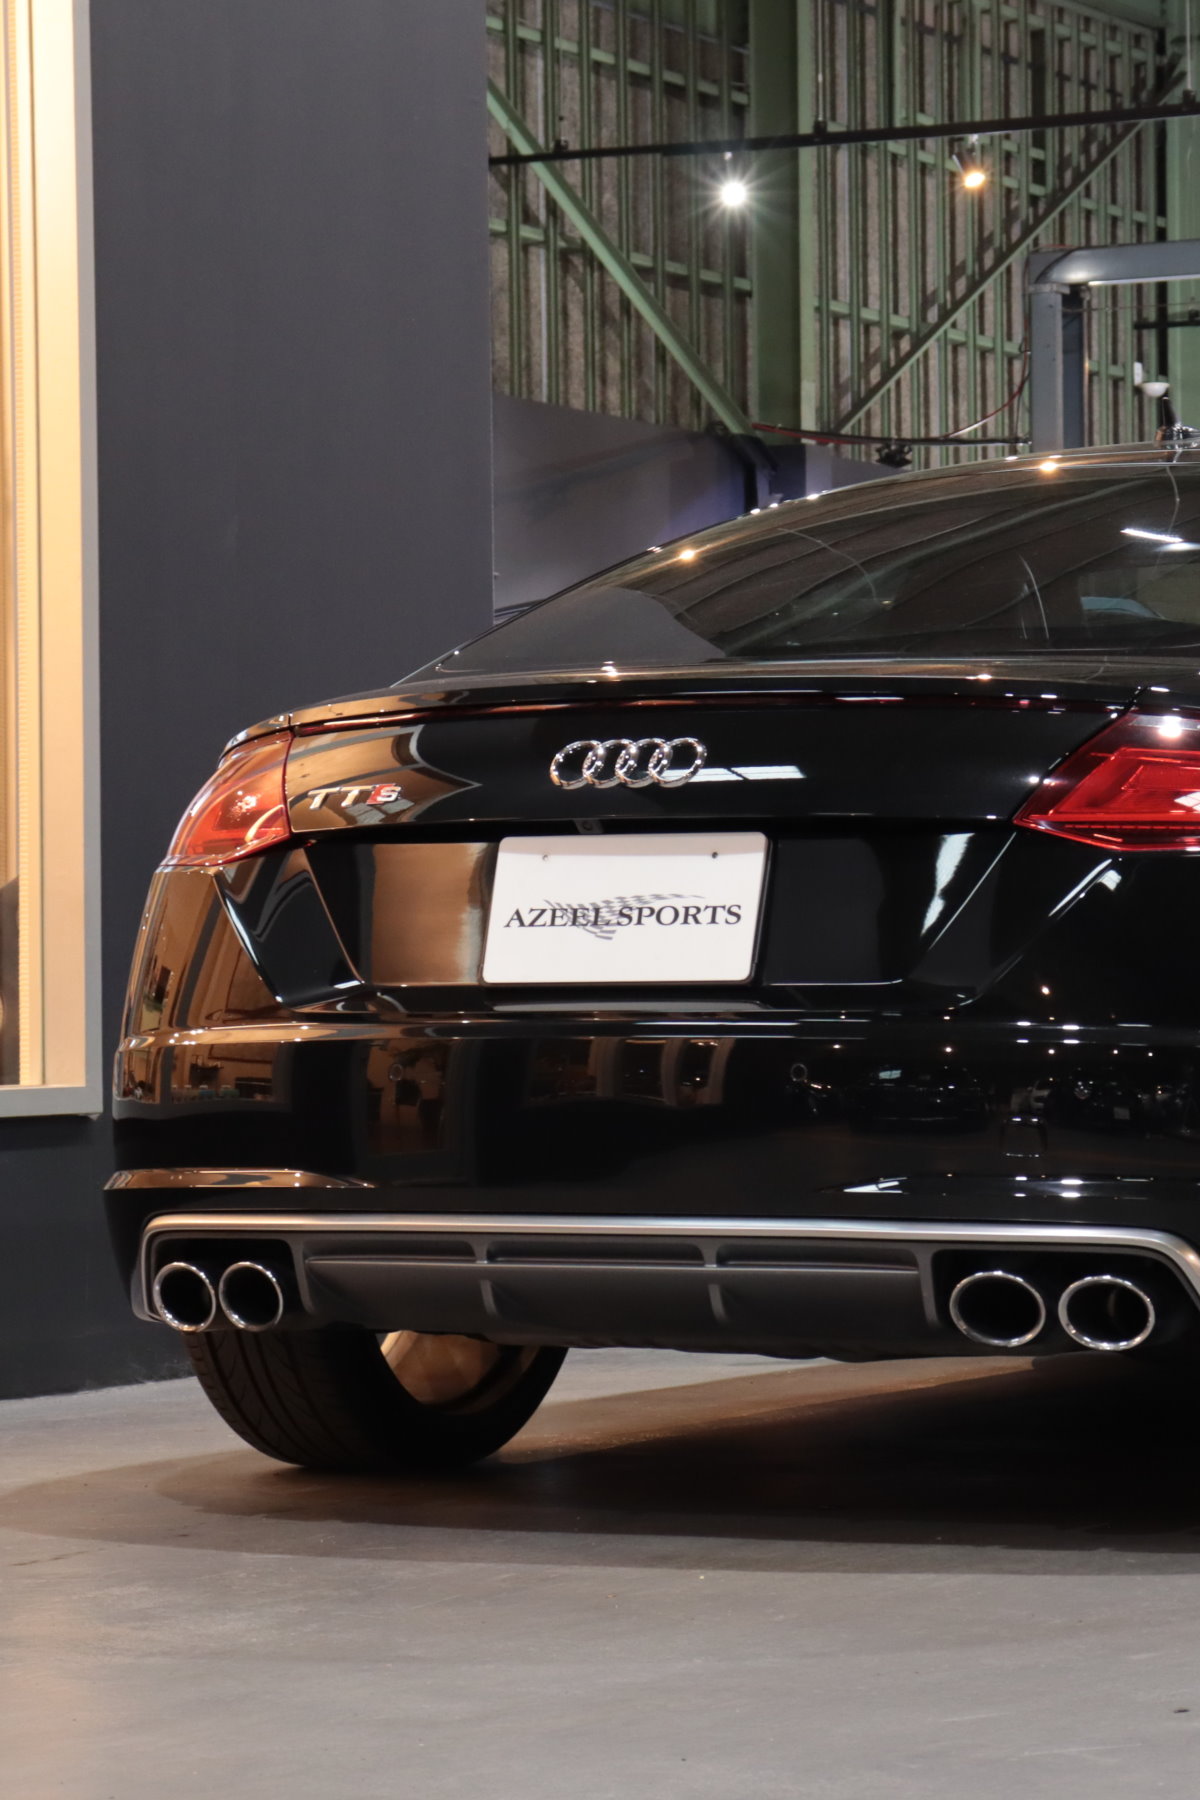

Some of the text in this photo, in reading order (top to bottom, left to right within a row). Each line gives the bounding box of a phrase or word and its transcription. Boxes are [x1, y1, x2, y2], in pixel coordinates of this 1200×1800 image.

[307, 783, 402, 810] TTS
[504, 904, 742, 928] AZEEL SPORTS
